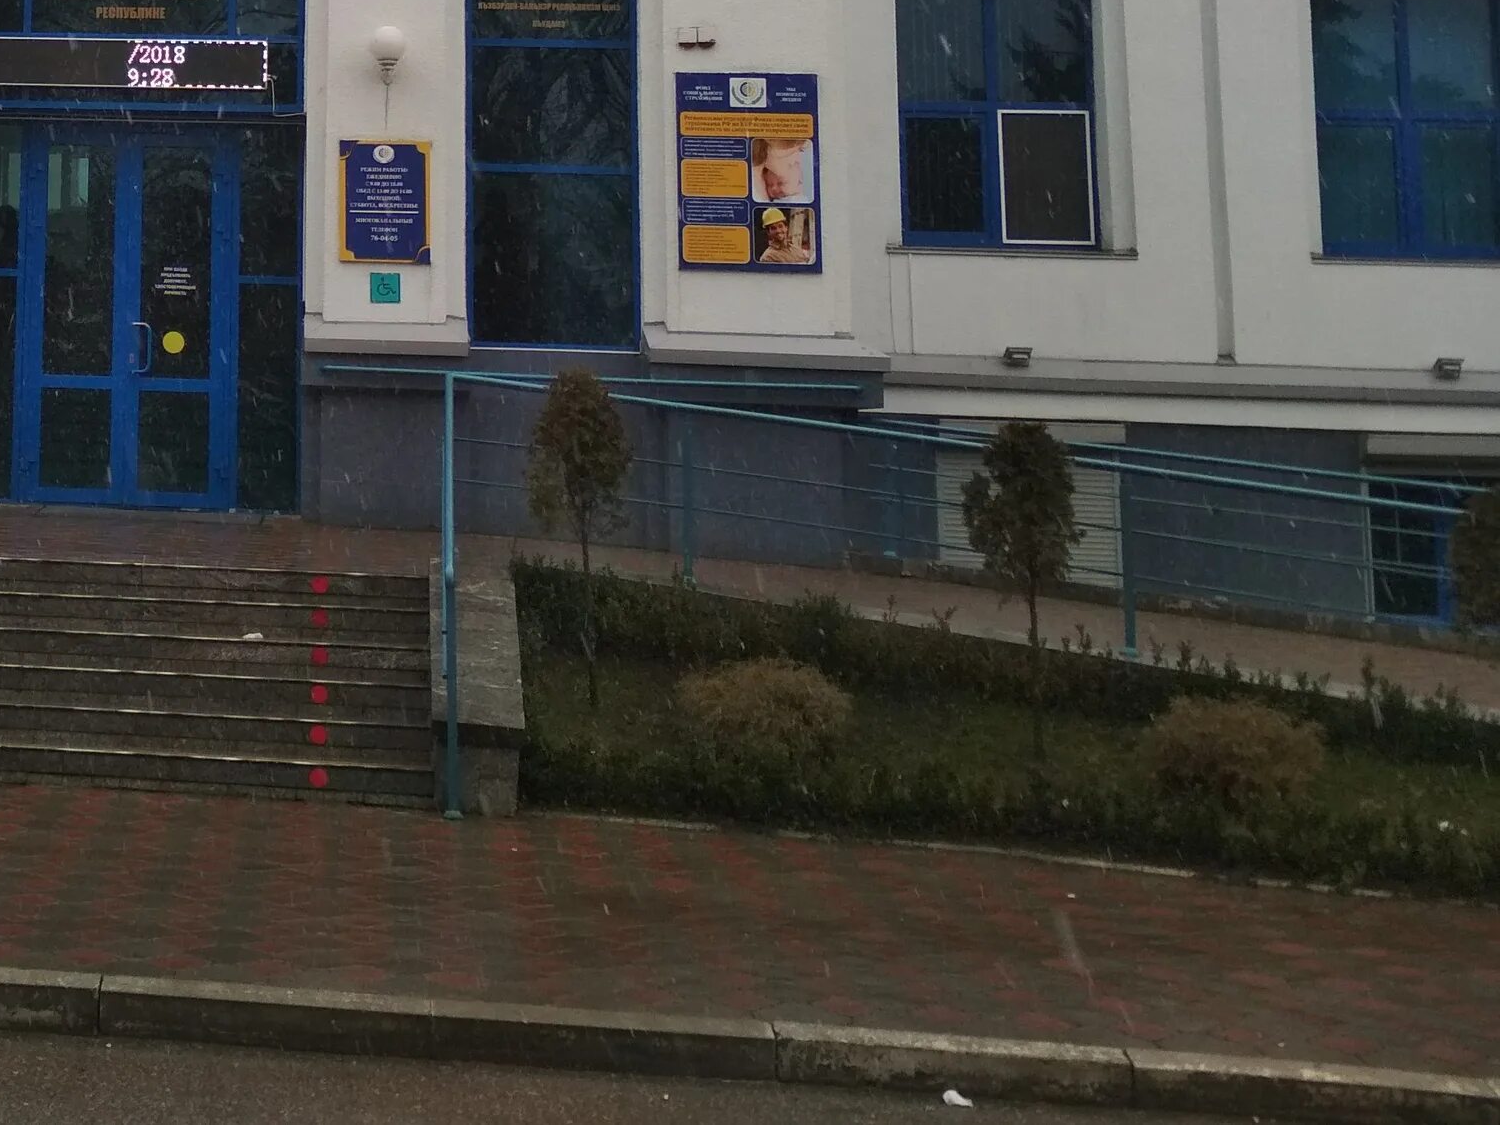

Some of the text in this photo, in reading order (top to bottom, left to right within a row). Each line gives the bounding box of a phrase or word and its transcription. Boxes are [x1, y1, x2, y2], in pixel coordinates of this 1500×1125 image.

[95, 7, 166, 20] РЕСПУБЛИКЕ
[127, 44, 186, 65] /2018
[127, 68, 174, 87] 9:28
